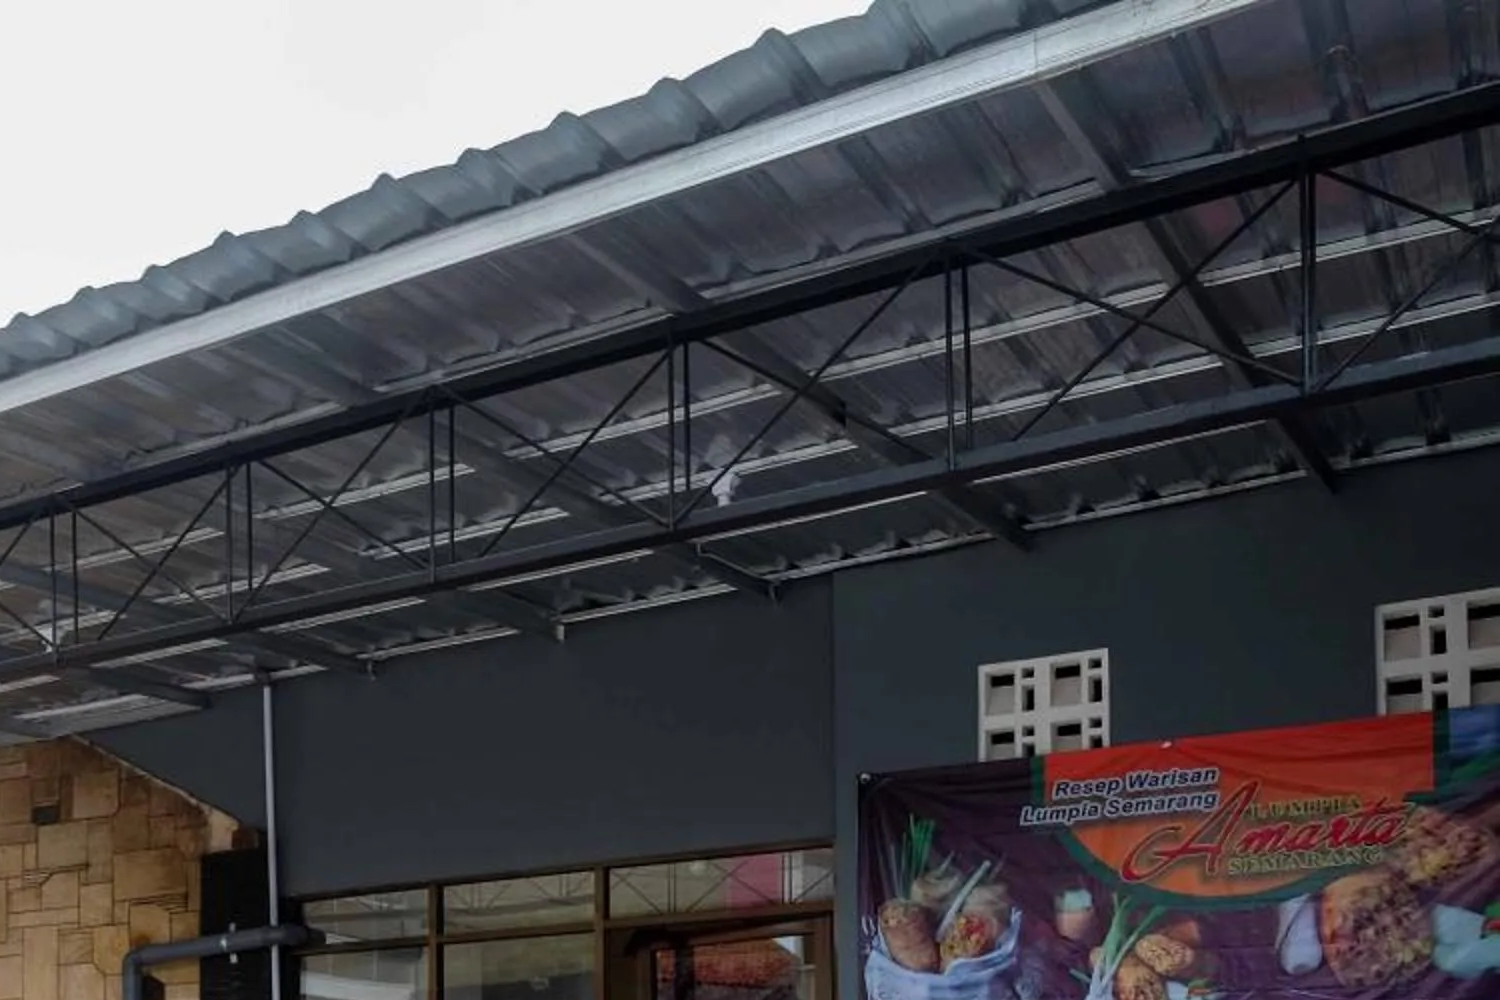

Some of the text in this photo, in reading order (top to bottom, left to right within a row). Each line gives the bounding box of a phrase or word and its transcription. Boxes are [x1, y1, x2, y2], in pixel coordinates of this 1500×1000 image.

[1055, 767, 1219, 799] Resep Warisan
[1020, 792, 1219, 826] Lumpia Semarang
[1120, 779, 1411, 881] Amarta
[1228, 848, 1384, 876] SEMARANG
